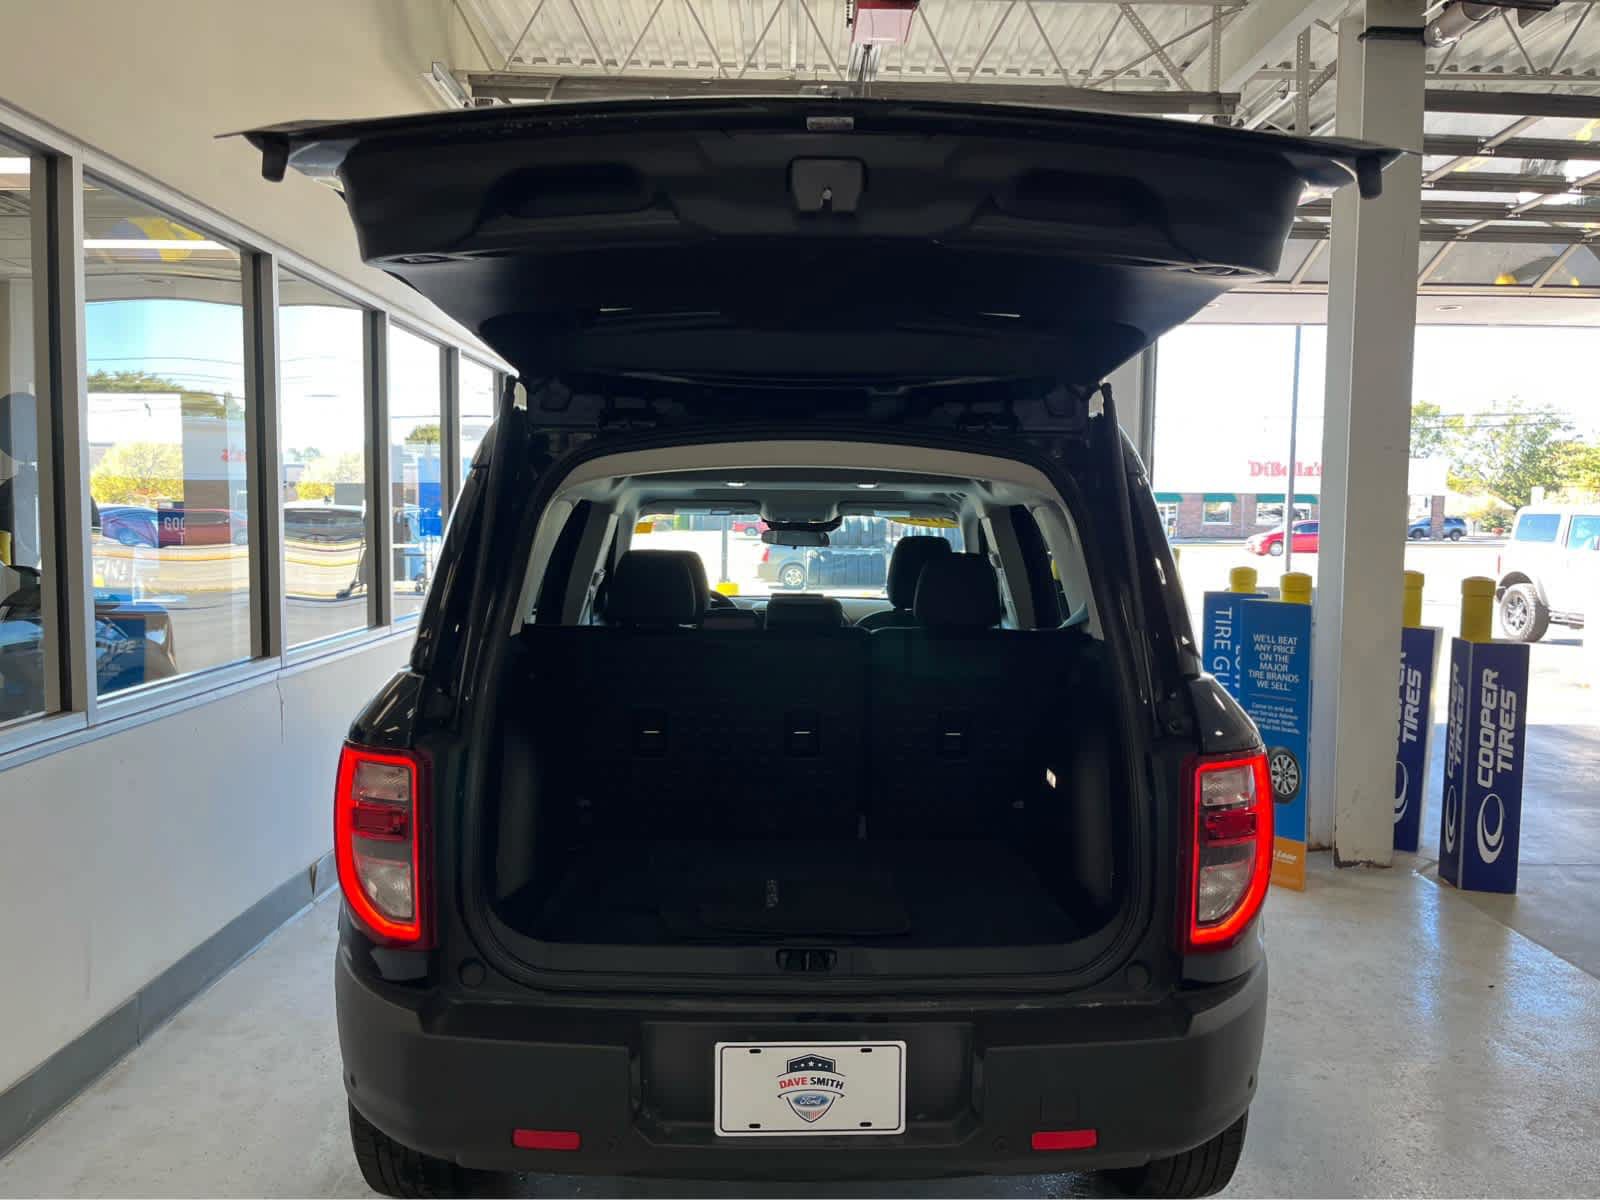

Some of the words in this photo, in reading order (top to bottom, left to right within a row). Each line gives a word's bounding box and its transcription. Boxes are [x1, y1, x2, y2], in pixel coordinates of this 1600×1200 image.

[1214, 607, 1232, 650] TIRE
[1253, 633, 1276, 643] WE'LL
[1278, 635, 1298, 646] BEAT
[1254, 643, 1271, 652] ANY
[1273, 645, 1297, 655] PRICE
[1259, 652, 1273, 661] ON
[1274, 654, 1289, 664] THE
[1259, 662, 1288, 673] MAJOR
[1248, 669, 1265, 679] TIRE
[1266, 671, 1300, 684] BRANDS
[1257, 679, 1269, 689] WE
[1402, 666, 1422, 744] TIRES
[1477, 667, 1499, 789] COOPER
[1496, 689, 1517, 774] TIRES
[778, 1076, 808, 1090] DAVE
[810, 1076, 844, 1090] SMITH
[799, 1094, 823, 1106] Ford
